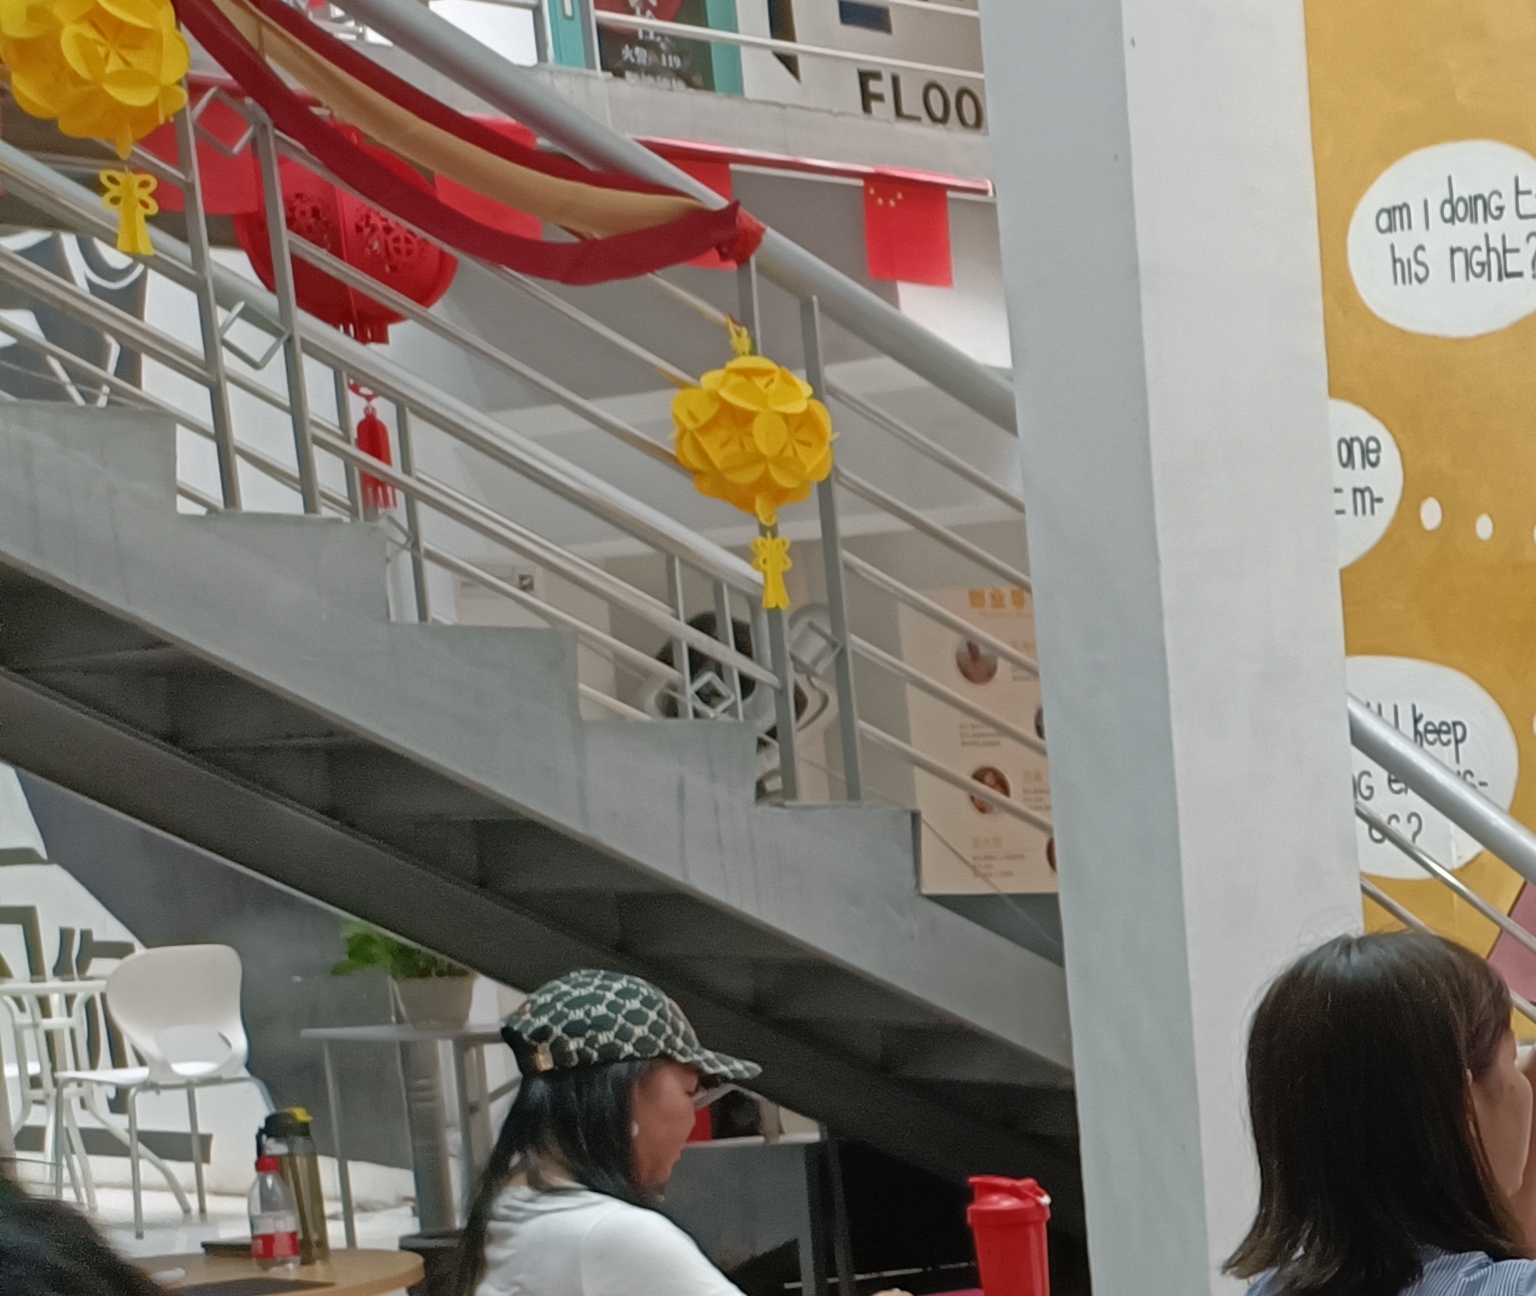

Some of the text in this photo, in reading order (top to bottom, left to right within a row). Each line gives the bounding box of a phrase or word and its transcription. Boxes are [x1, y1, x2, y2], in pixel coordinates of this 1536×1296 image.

[1375, 201, 1412, 234] am
[1440, 174, 1505, 226] doing
[1390, 242, 1430, 286] his
[1337, 435, 1382, 471] one
[1411, 702, 1468, 765] keep
